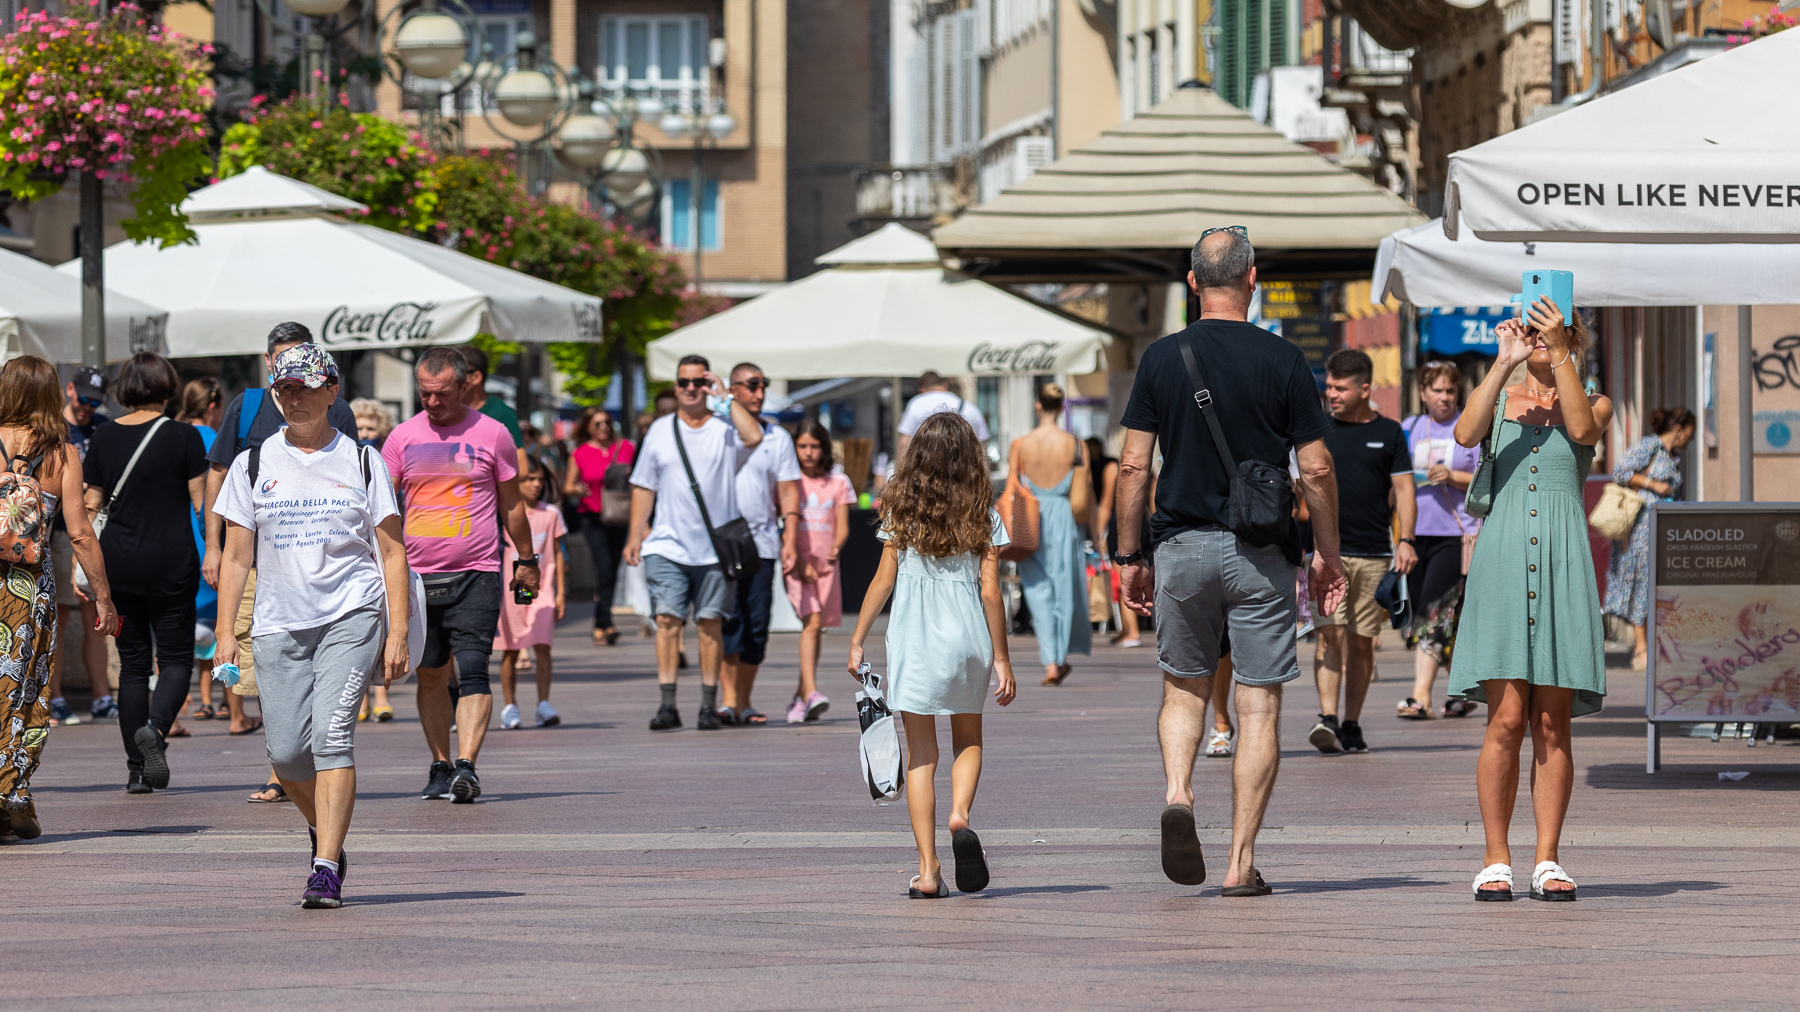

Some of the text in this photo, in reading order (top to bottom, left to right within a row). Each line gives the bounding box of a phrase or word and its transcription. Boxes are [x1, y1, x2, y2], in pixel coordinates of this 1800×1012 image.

[1517, 182, 1800, 208] OPEN LIKE NEVER
[1461, 319, 1500, 345] ZL
[264, 498, 351, 510] FIACCOLA DELLA PACE
[316, 537, 332, 545] 2005
[1667, 529, 1745, 542] SLADOLED
[1667, 543, 1758, 552] OKUSI KRAŠEVIH SLASTICA
[1667, 556, 1746, 569] ICE CREAM
[1667, 571, 1700, 579] ORIGINAL
[1721, 570, 1758, 578] FLAVOURS
[325, 666, 365, 748] KAPPA SPORT
